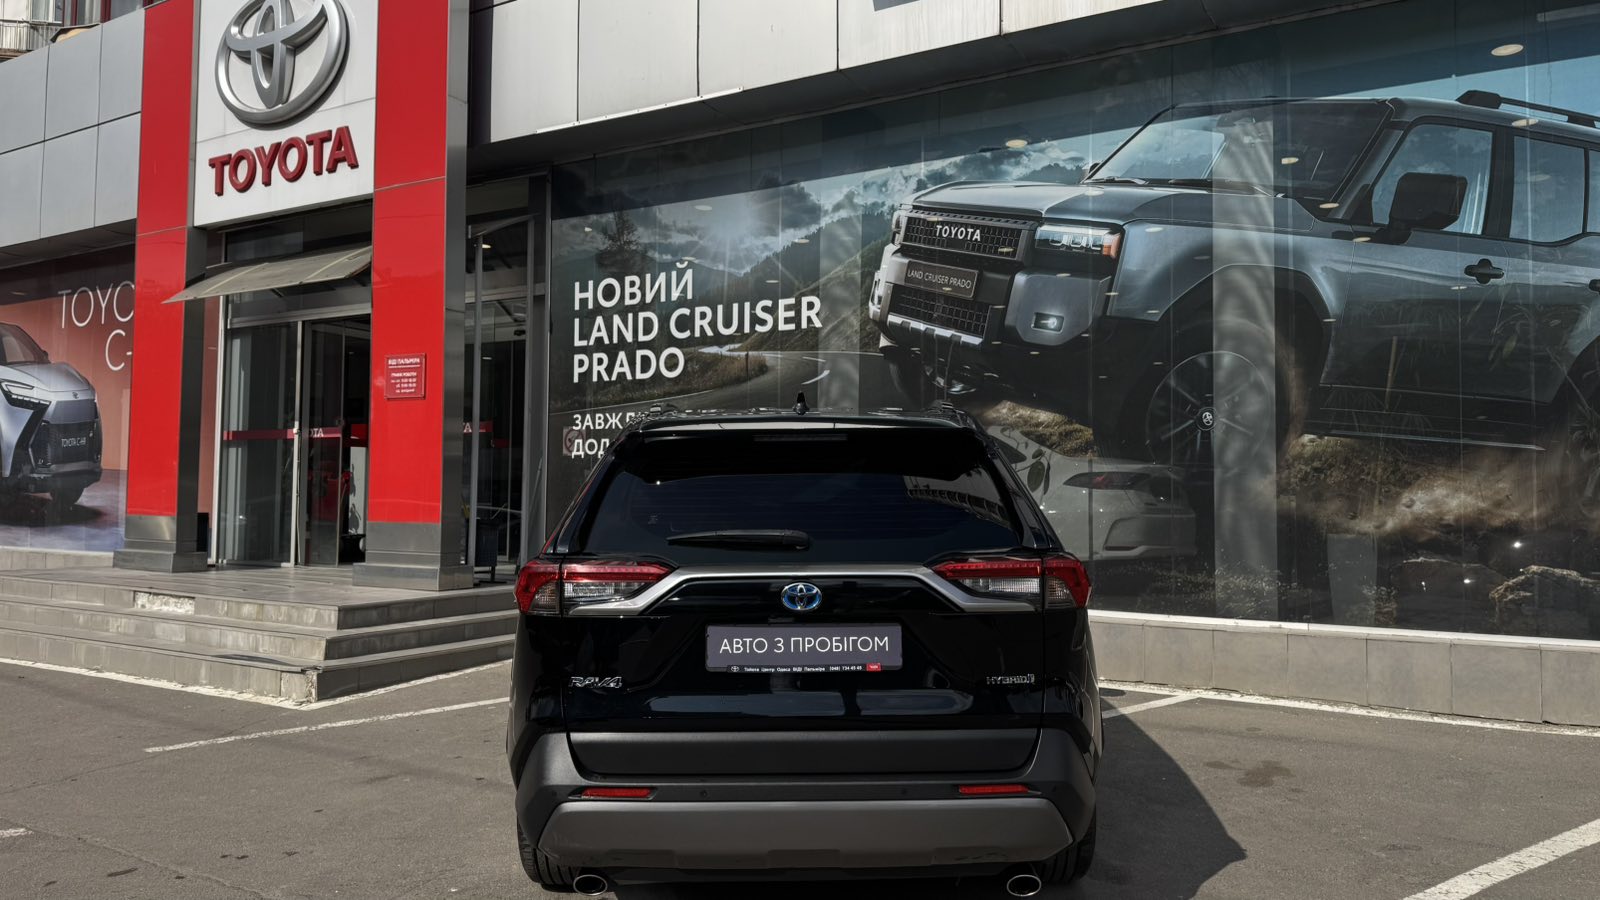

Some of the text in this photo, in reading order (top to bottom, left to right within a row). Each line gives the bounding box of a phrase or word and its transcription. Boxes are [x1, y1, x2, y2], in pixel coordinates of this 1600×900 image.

[208, 126, 359, 197] TOYOTA
[936, 225, 981, 242] TOYOTA
[574, 261, 693, 311] НОВИЙ
[907, 269, 972, 289] LAND CRUISER PRADO
[573, 295, 823, 347] LAND CRUISER
[573, 347, 685, 384] PRADO
[719, 636, 889, 654] АВТО З ПРОБІГОМ
[569, 676, 622, 689] RAV4
[986, 675, 1027, 685] HYBRID
